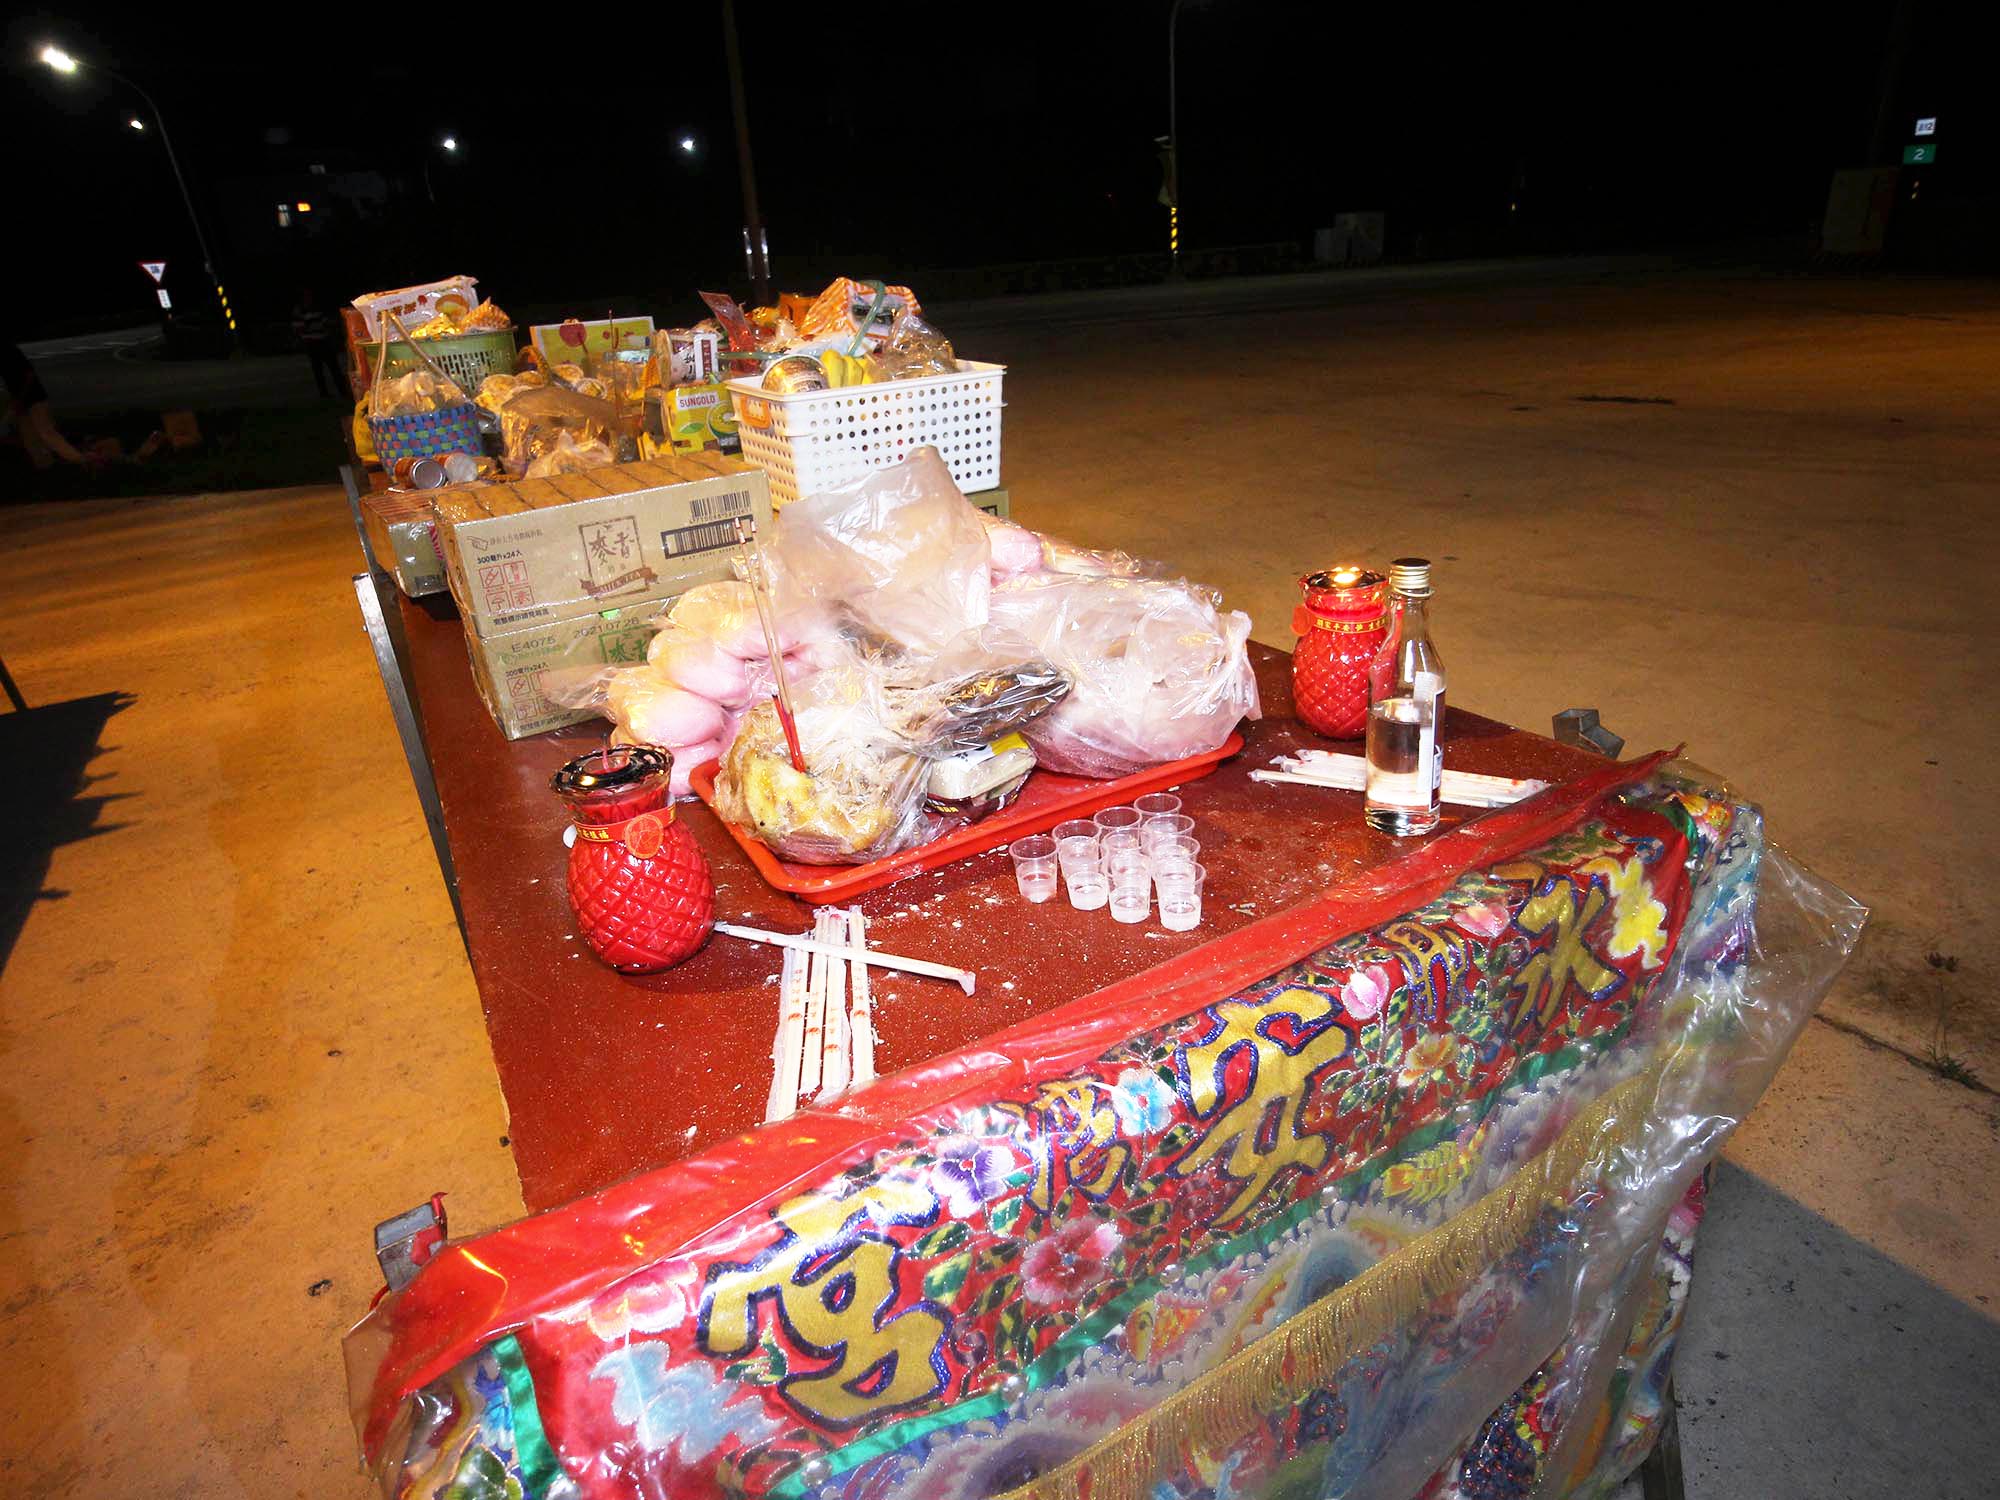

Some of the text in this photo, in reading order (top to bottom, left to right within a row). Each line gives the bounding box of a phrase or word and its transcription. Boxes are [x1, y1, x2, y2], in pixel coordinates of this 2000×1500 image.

[1913, 148, 1926, 161] 2
[680, 394, 716, 408] SUNGOLD
[589, 526, 635, 566] 麥香
[511, 636, 556, 654] E4075
